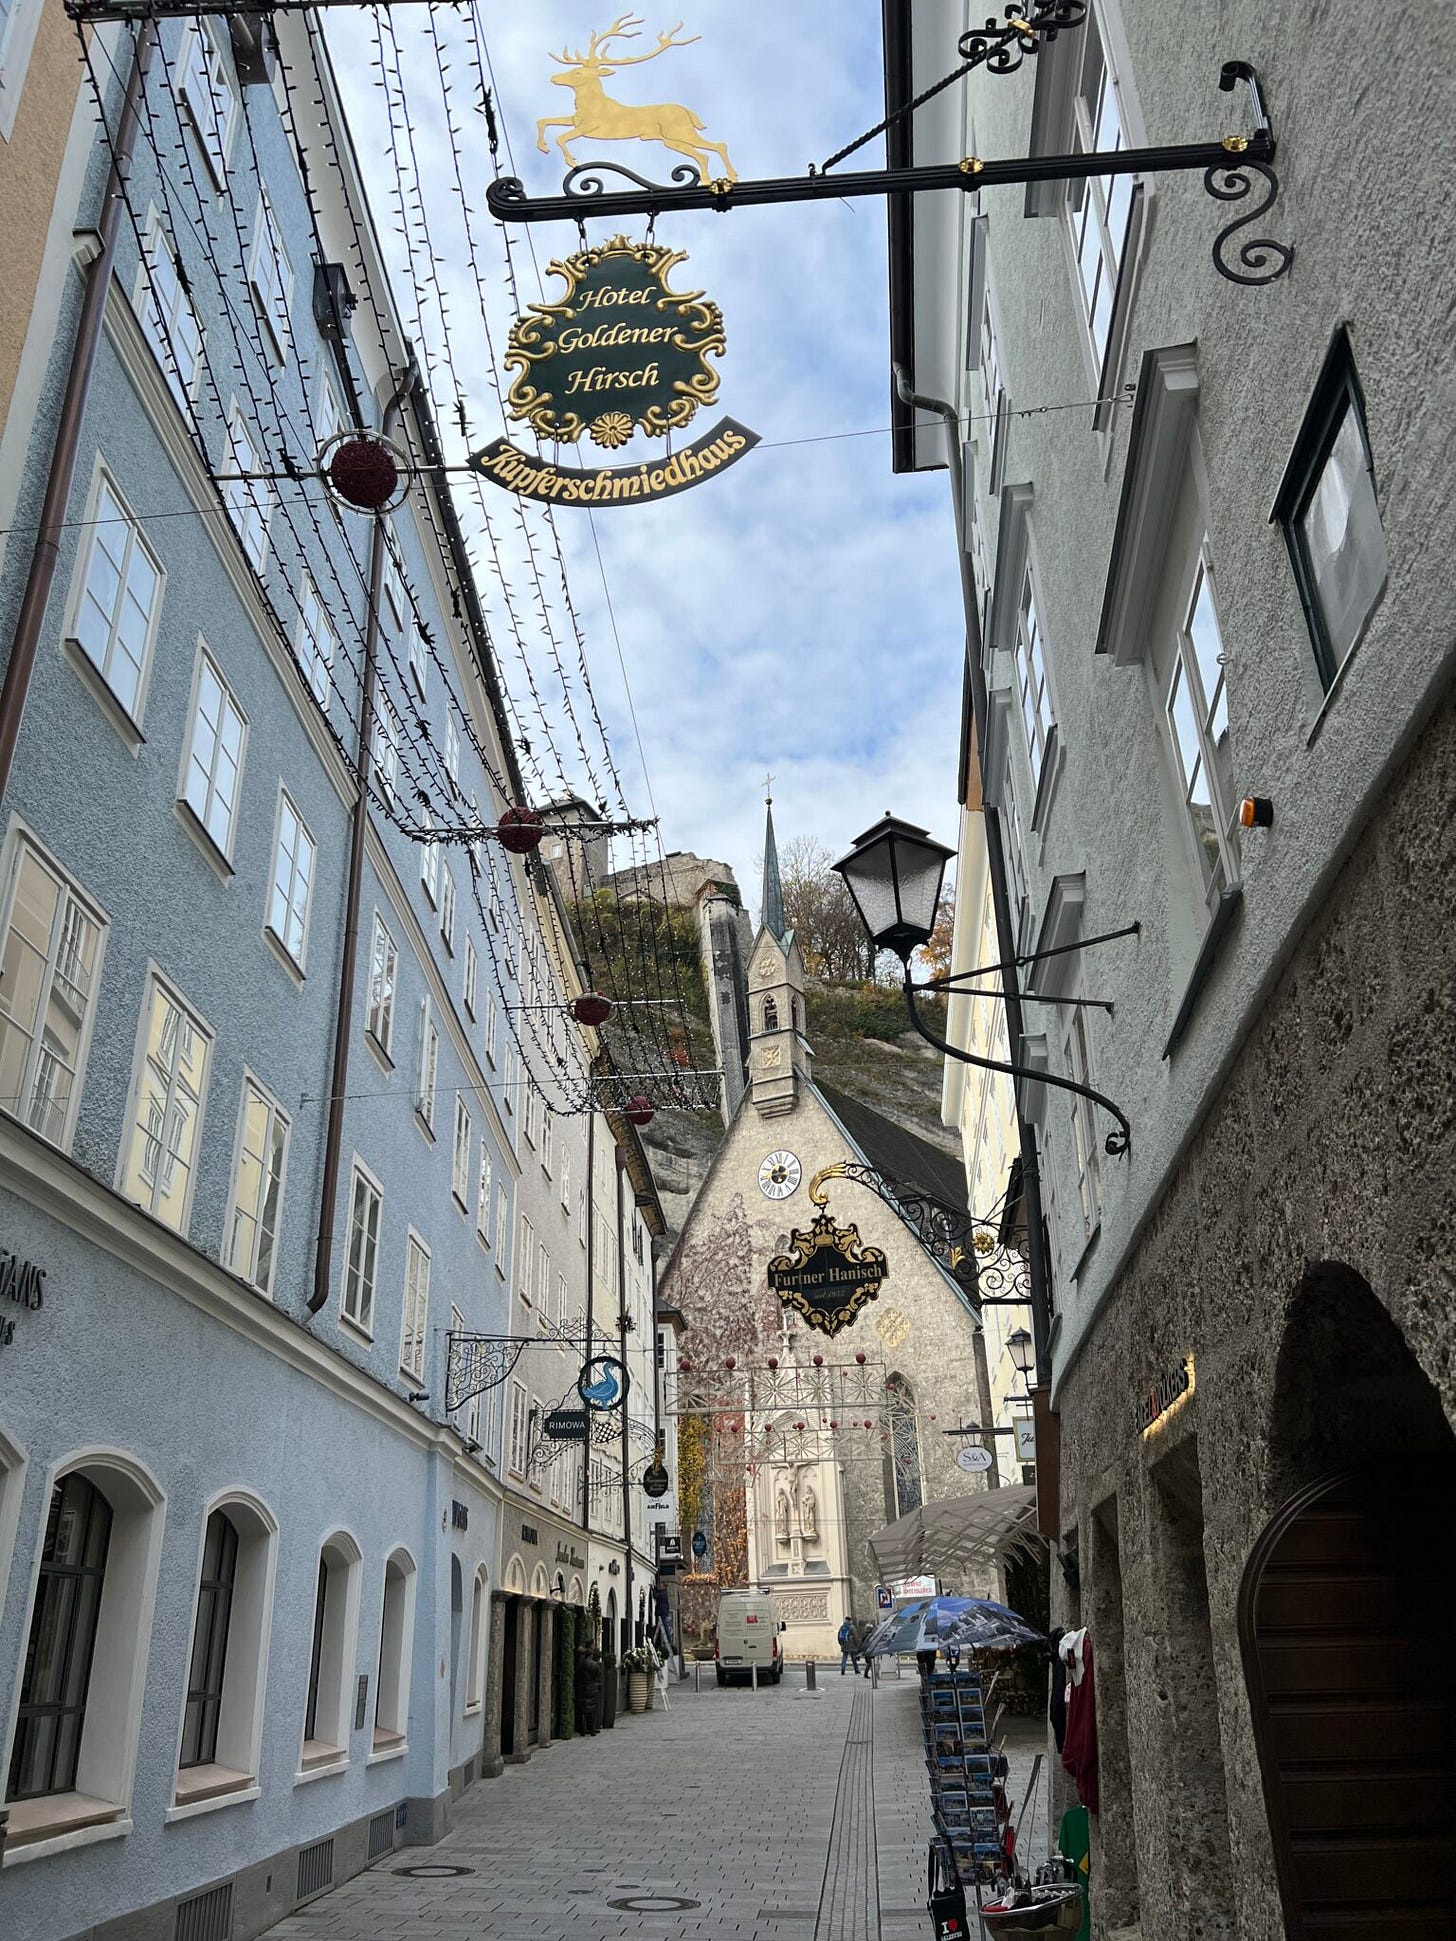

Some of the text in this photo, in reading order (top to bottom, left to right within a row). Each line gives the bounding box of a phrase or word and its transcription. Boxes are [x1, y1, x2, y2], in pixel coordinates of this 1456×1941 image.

[576, 285, 657, 312] Hotel
[557, 322, 679, 353] Goldener
[565, 362, 660, 394] Hirsch
[480, 430, 748, 501] Kupferschmiedhaus
[774, 1264, 883, 1288] Furtner Hanisch
[549, 1421, 586, 1430] RIMOWA
[1021, 1432, 1036, 1446] Ju
[941, 1921, 950, 1934] I
